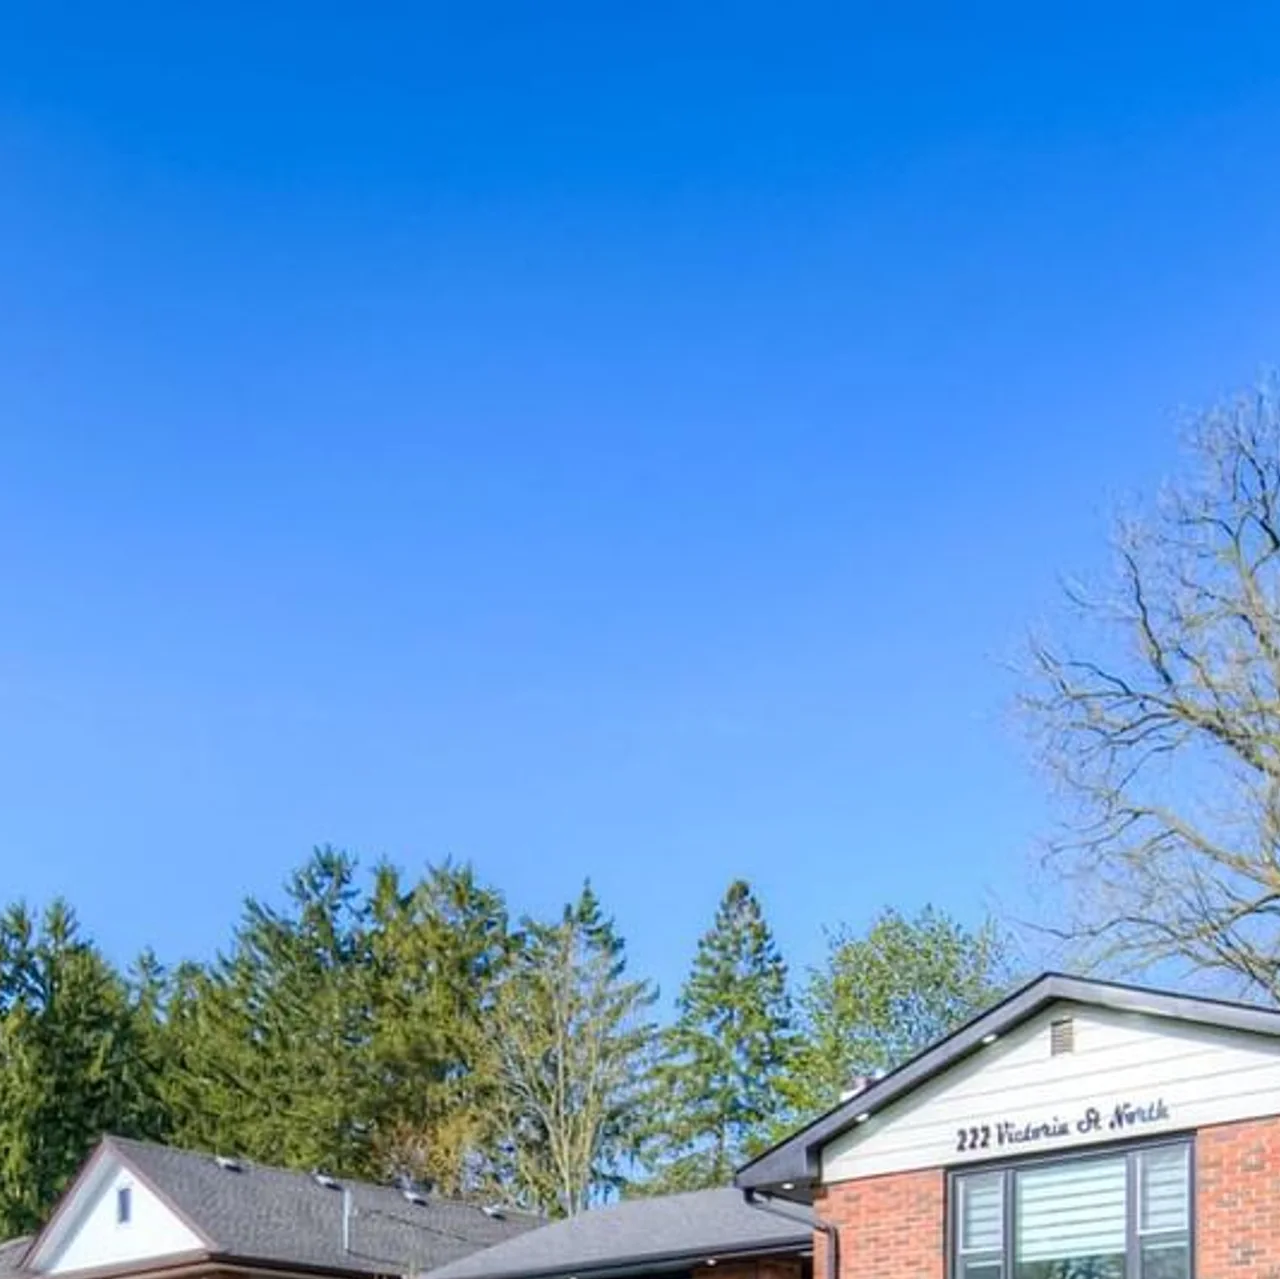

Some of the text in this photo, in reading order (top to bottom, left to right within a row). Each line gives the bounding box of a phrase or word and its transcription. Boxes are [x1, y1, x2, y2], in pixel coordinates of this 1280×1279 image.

[957, 1098, 1169, 1152] 222 Victoria St North
